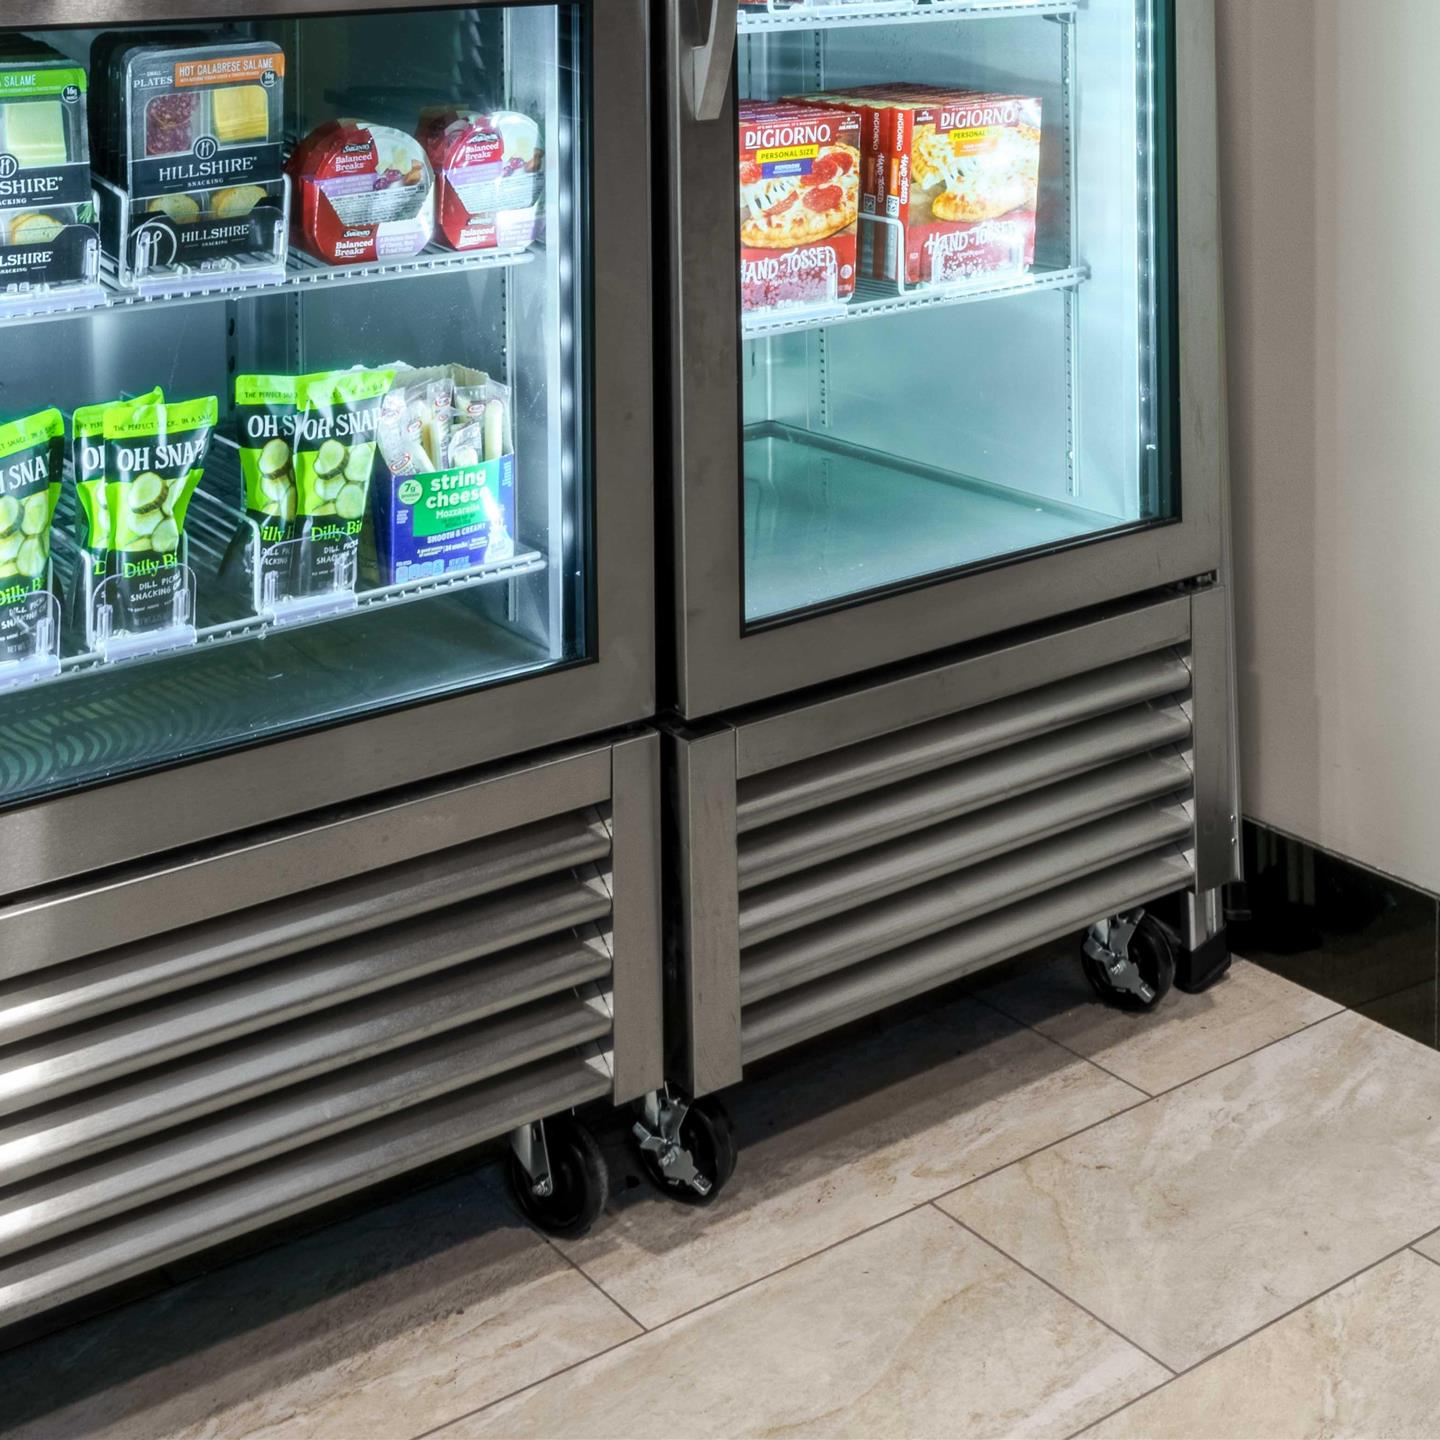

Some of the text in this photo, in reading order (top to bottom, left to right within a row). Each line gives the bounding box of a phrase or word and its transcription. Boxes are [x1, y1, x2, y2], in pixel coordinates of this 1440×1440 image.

[179, 65, 194, 76] HOT
[197, 62, 241, 75] CALABRESE
[243, 58, 273, 70] SALAME
[4, 74, 36, 87] SALAME
[133, 76, 173, 88] PLATES
[66, 87, 77, 96] 16g
[954, 131, 986, 139] PERSONAL
[465, 142, 499, 154] Balanced
[761, 148, 814, 160] PERSONAL SIZE
[335, 152, 372, 164] Balanced
[465, 151, 492, 161] Breaks
[158, 157, 254, 182] HILLSHIRE
[335, 162, 364, 172] Breaks
[187, 178, 224, 187] SNACKING
[181, 224, 249, 243] HILLSHIRE
[336, 239, 374, 249] Balanced
[335, 248, 365, 257] Breaks
[127, 422, 154, 431] PERFECT
[247, 415, 278, 438] OH
[303, 417, 331, 440] OH
[117, 446, 150, 472] OH
[8, 449, 50, 491] SNA
[431, 469, 487, 492] string
[405, 483, 416, 493] 7g
[425, 487, 488, 509] cheese
[260, 526, 285, 544] illy
[311, 524, 345, 542] Dilly
[427, 531, 455, 544] SMOOTH
[462, 523, 486, 535] CREAMY
[324, 545, 340, 554] DILL
[123, 558, 160, 578] Dilly
[139, 580, 158, 591] DILL
[130, 586, 171, 602] SNACKING
